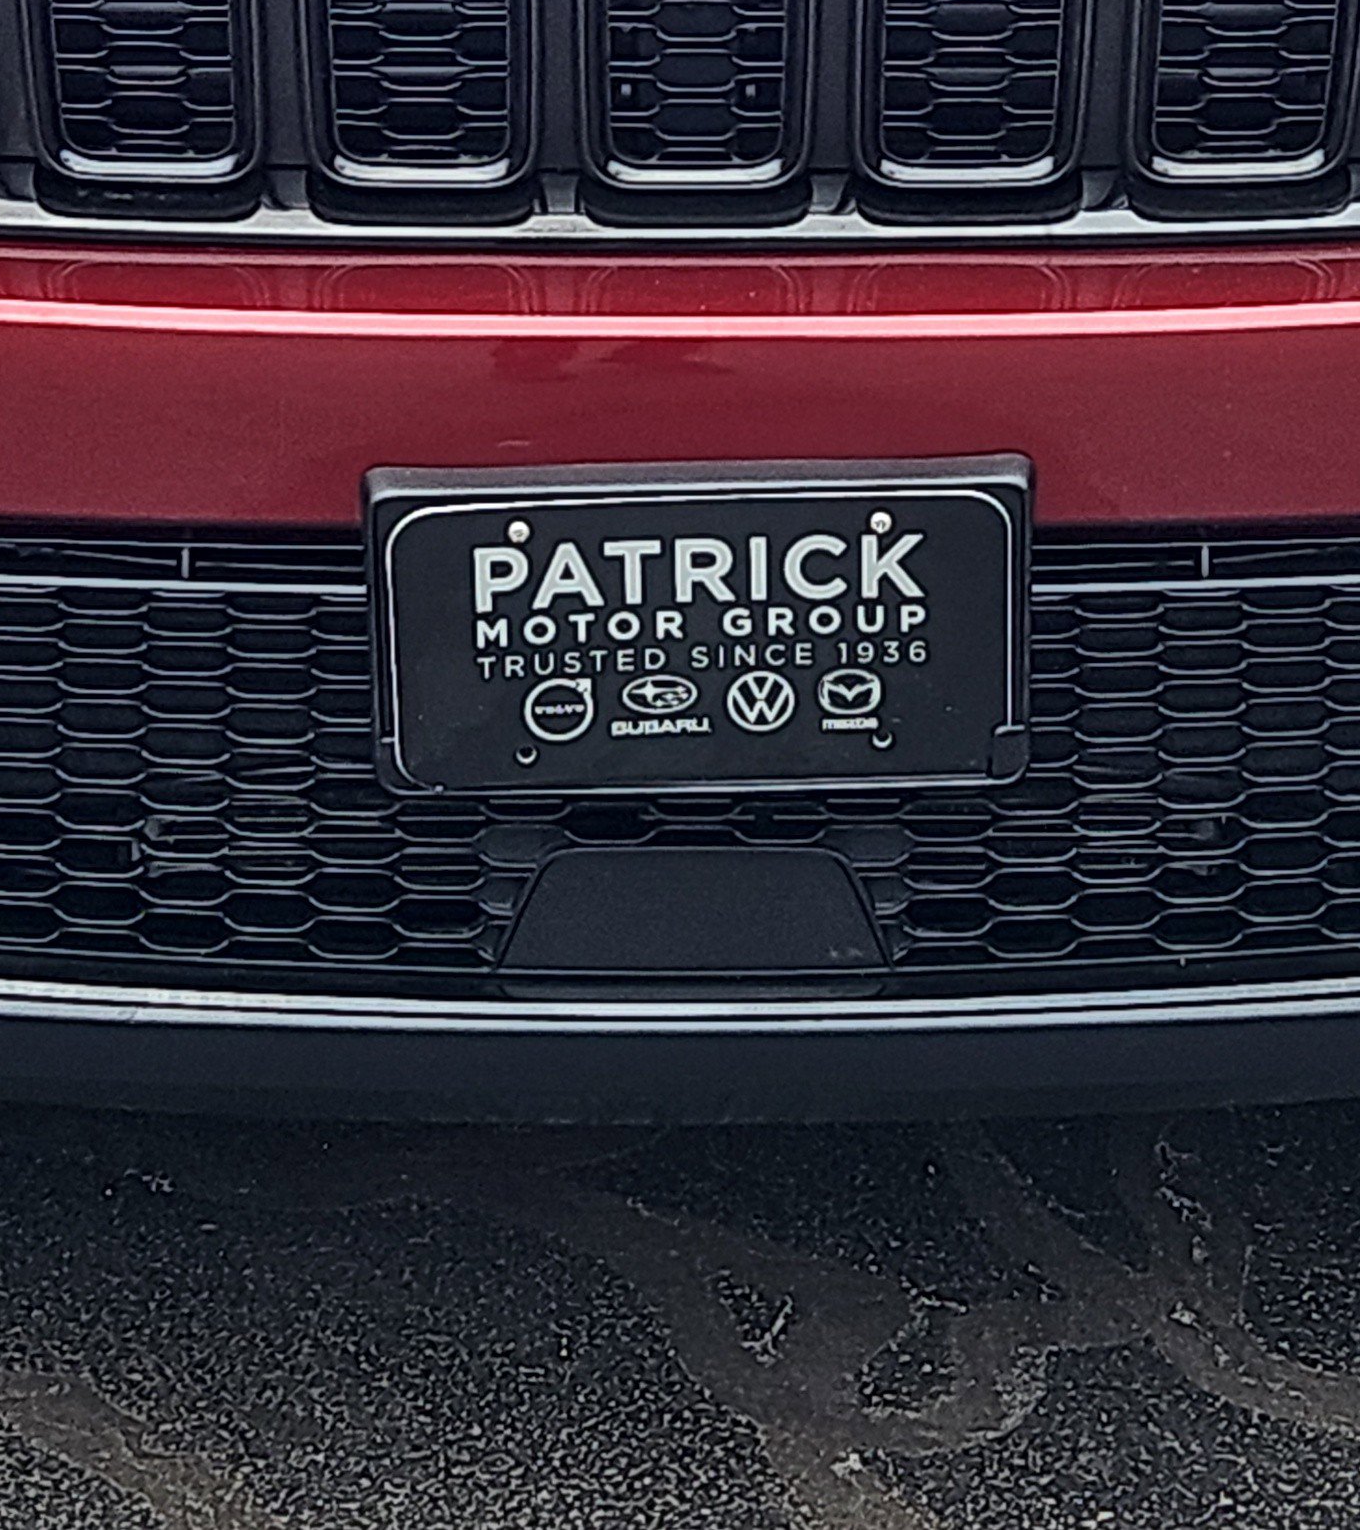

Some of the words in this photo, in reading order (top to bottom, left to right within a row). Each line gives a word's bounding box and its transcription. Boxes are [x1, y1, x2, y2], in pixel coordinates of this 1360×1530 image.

[473, 533, 926, 614] PATRICK
[476, 610, 684, 650] MOTOR
[722, 604, 926, 637] GROUP
[476, 647, 667, 680] TRUSTED
[691, 642, 814, 669] SINCE
[837, 640, 927, 665] 1936
[611, 717, 712, 737] SUBARU
